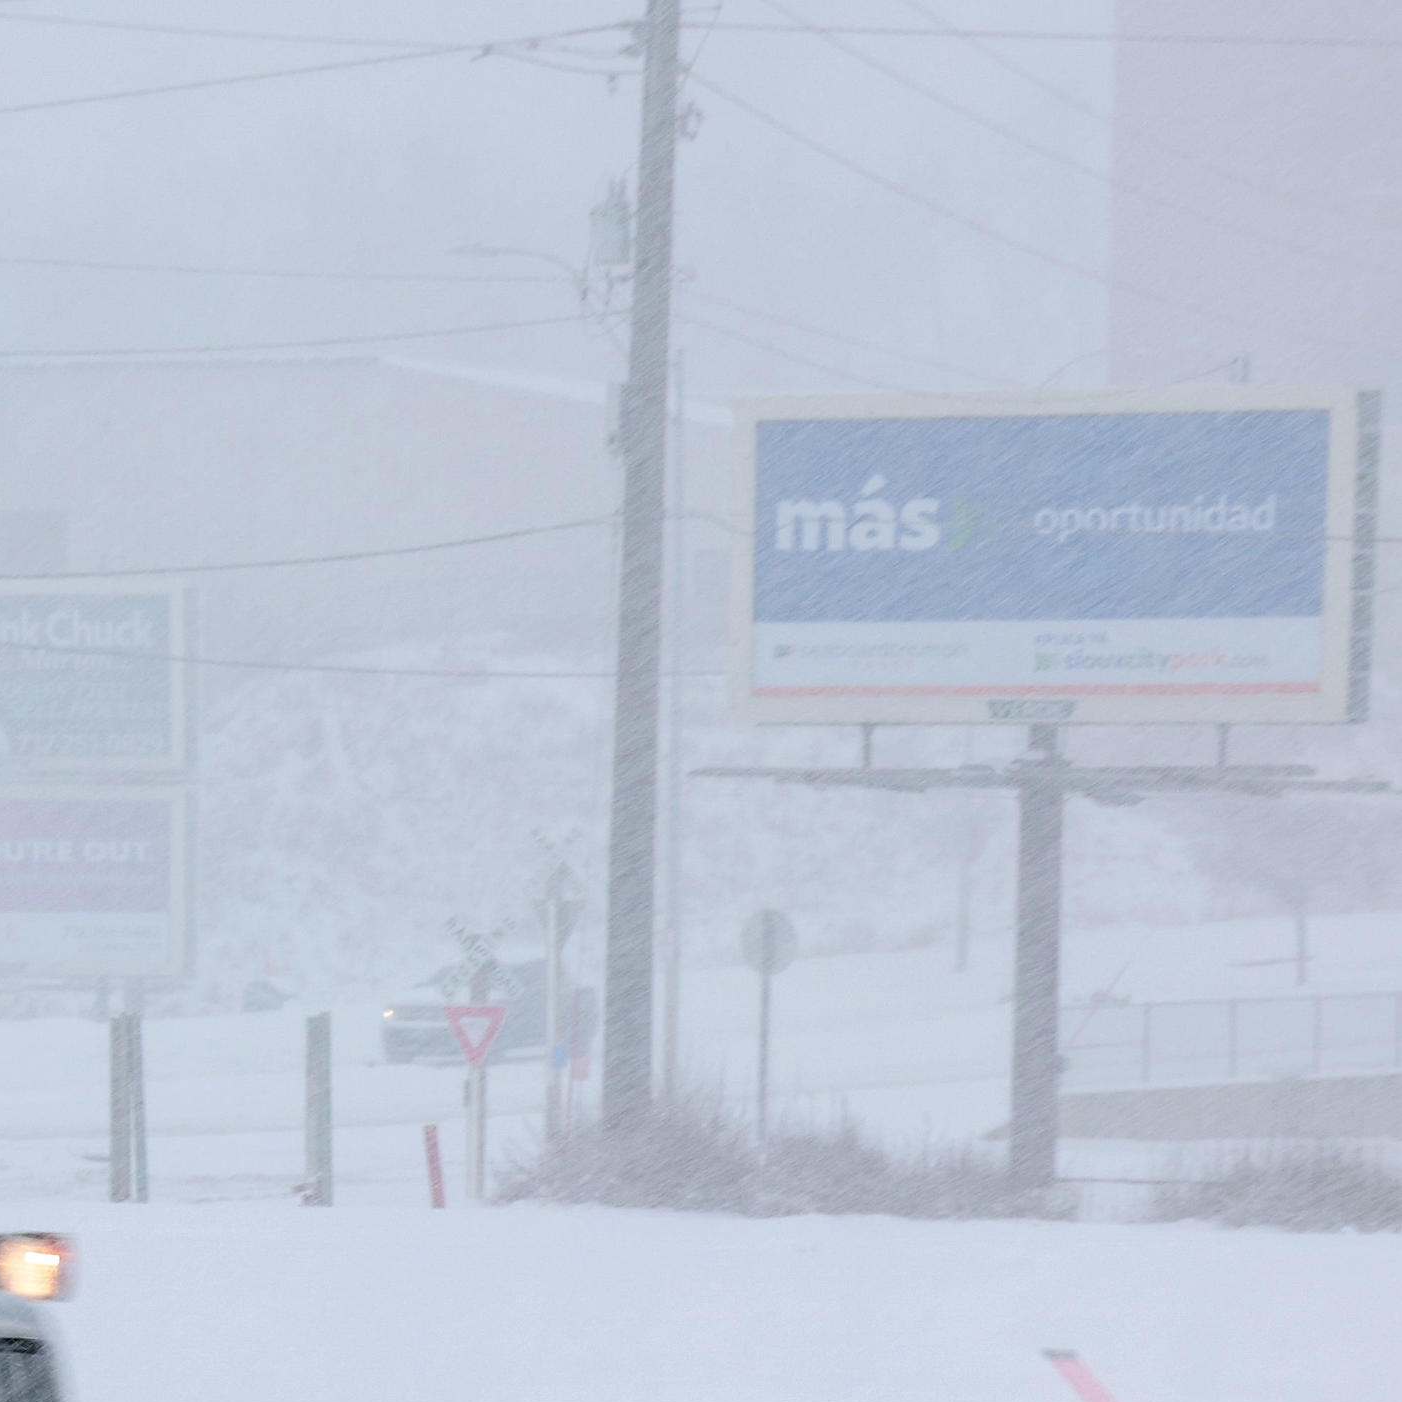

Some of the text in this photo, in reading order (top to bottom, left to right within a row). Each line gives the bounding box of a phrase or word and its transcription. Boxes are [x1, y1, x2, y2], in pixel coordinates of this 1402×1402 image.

[775, 474, 1275, 551] más oportunidad
[46, 607, 156, 648] Chuck
